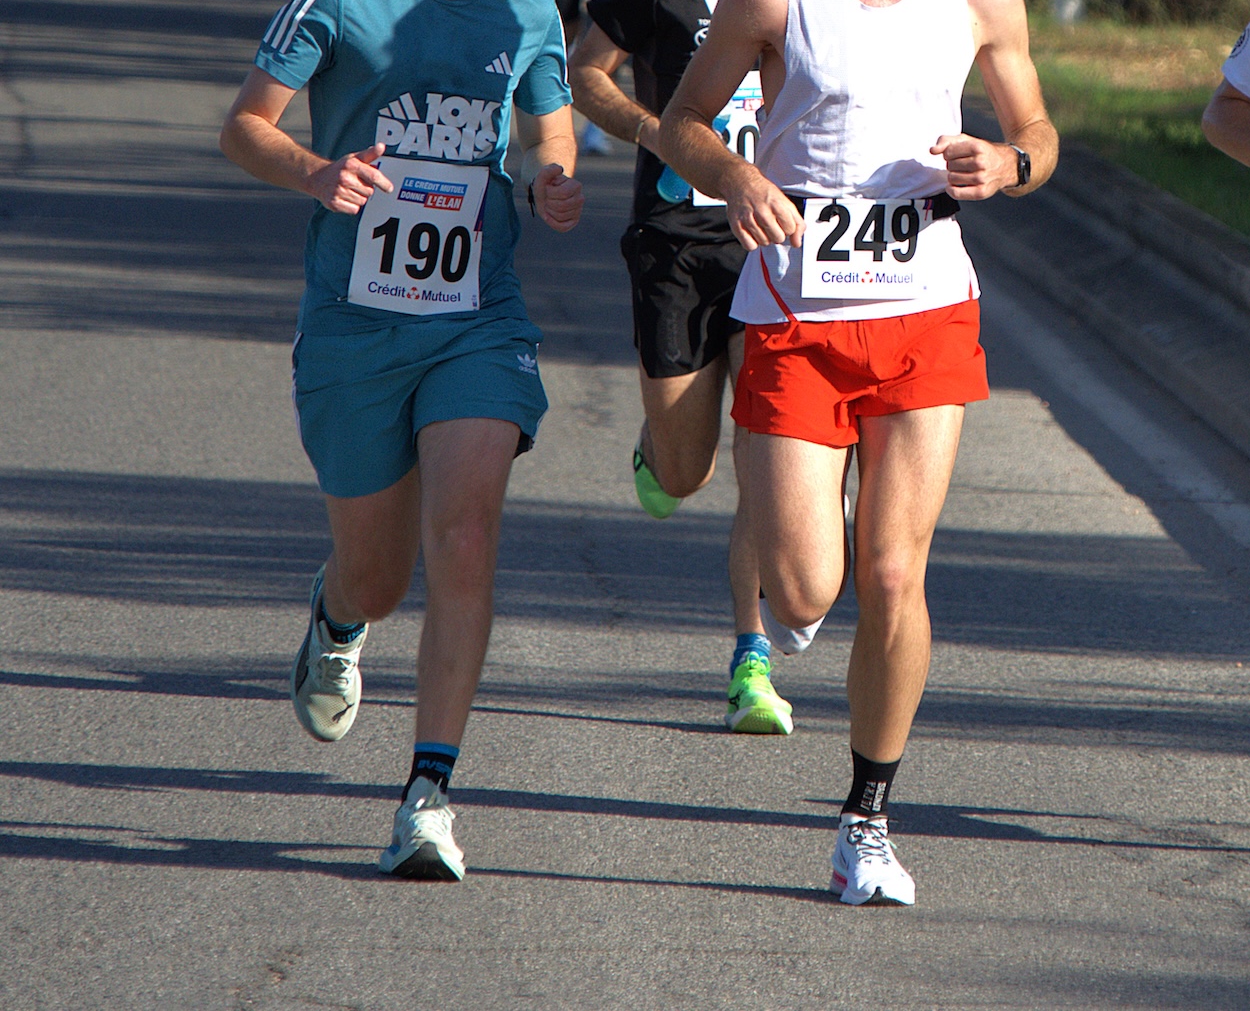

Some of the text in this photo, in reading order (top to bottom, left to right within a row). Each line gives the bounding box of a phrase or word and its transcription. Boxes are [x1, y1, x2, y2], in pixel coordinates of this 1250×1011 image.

[426, 92, 502, 132] 10K
[375, 116, 497, 161] PARIS
[400, 191, 426, 202] DONNE
[404, 179, 465, 194] LE CRÉDIT MUTUEL
[816, 204, 919, 262] 249
[372, 217, 471, 283] 190
[367, 281, 406, 297] Crédit
[421, 289, 461, 302] Mutuel
[821, 271, 913, 284] Crédit Mutuel
